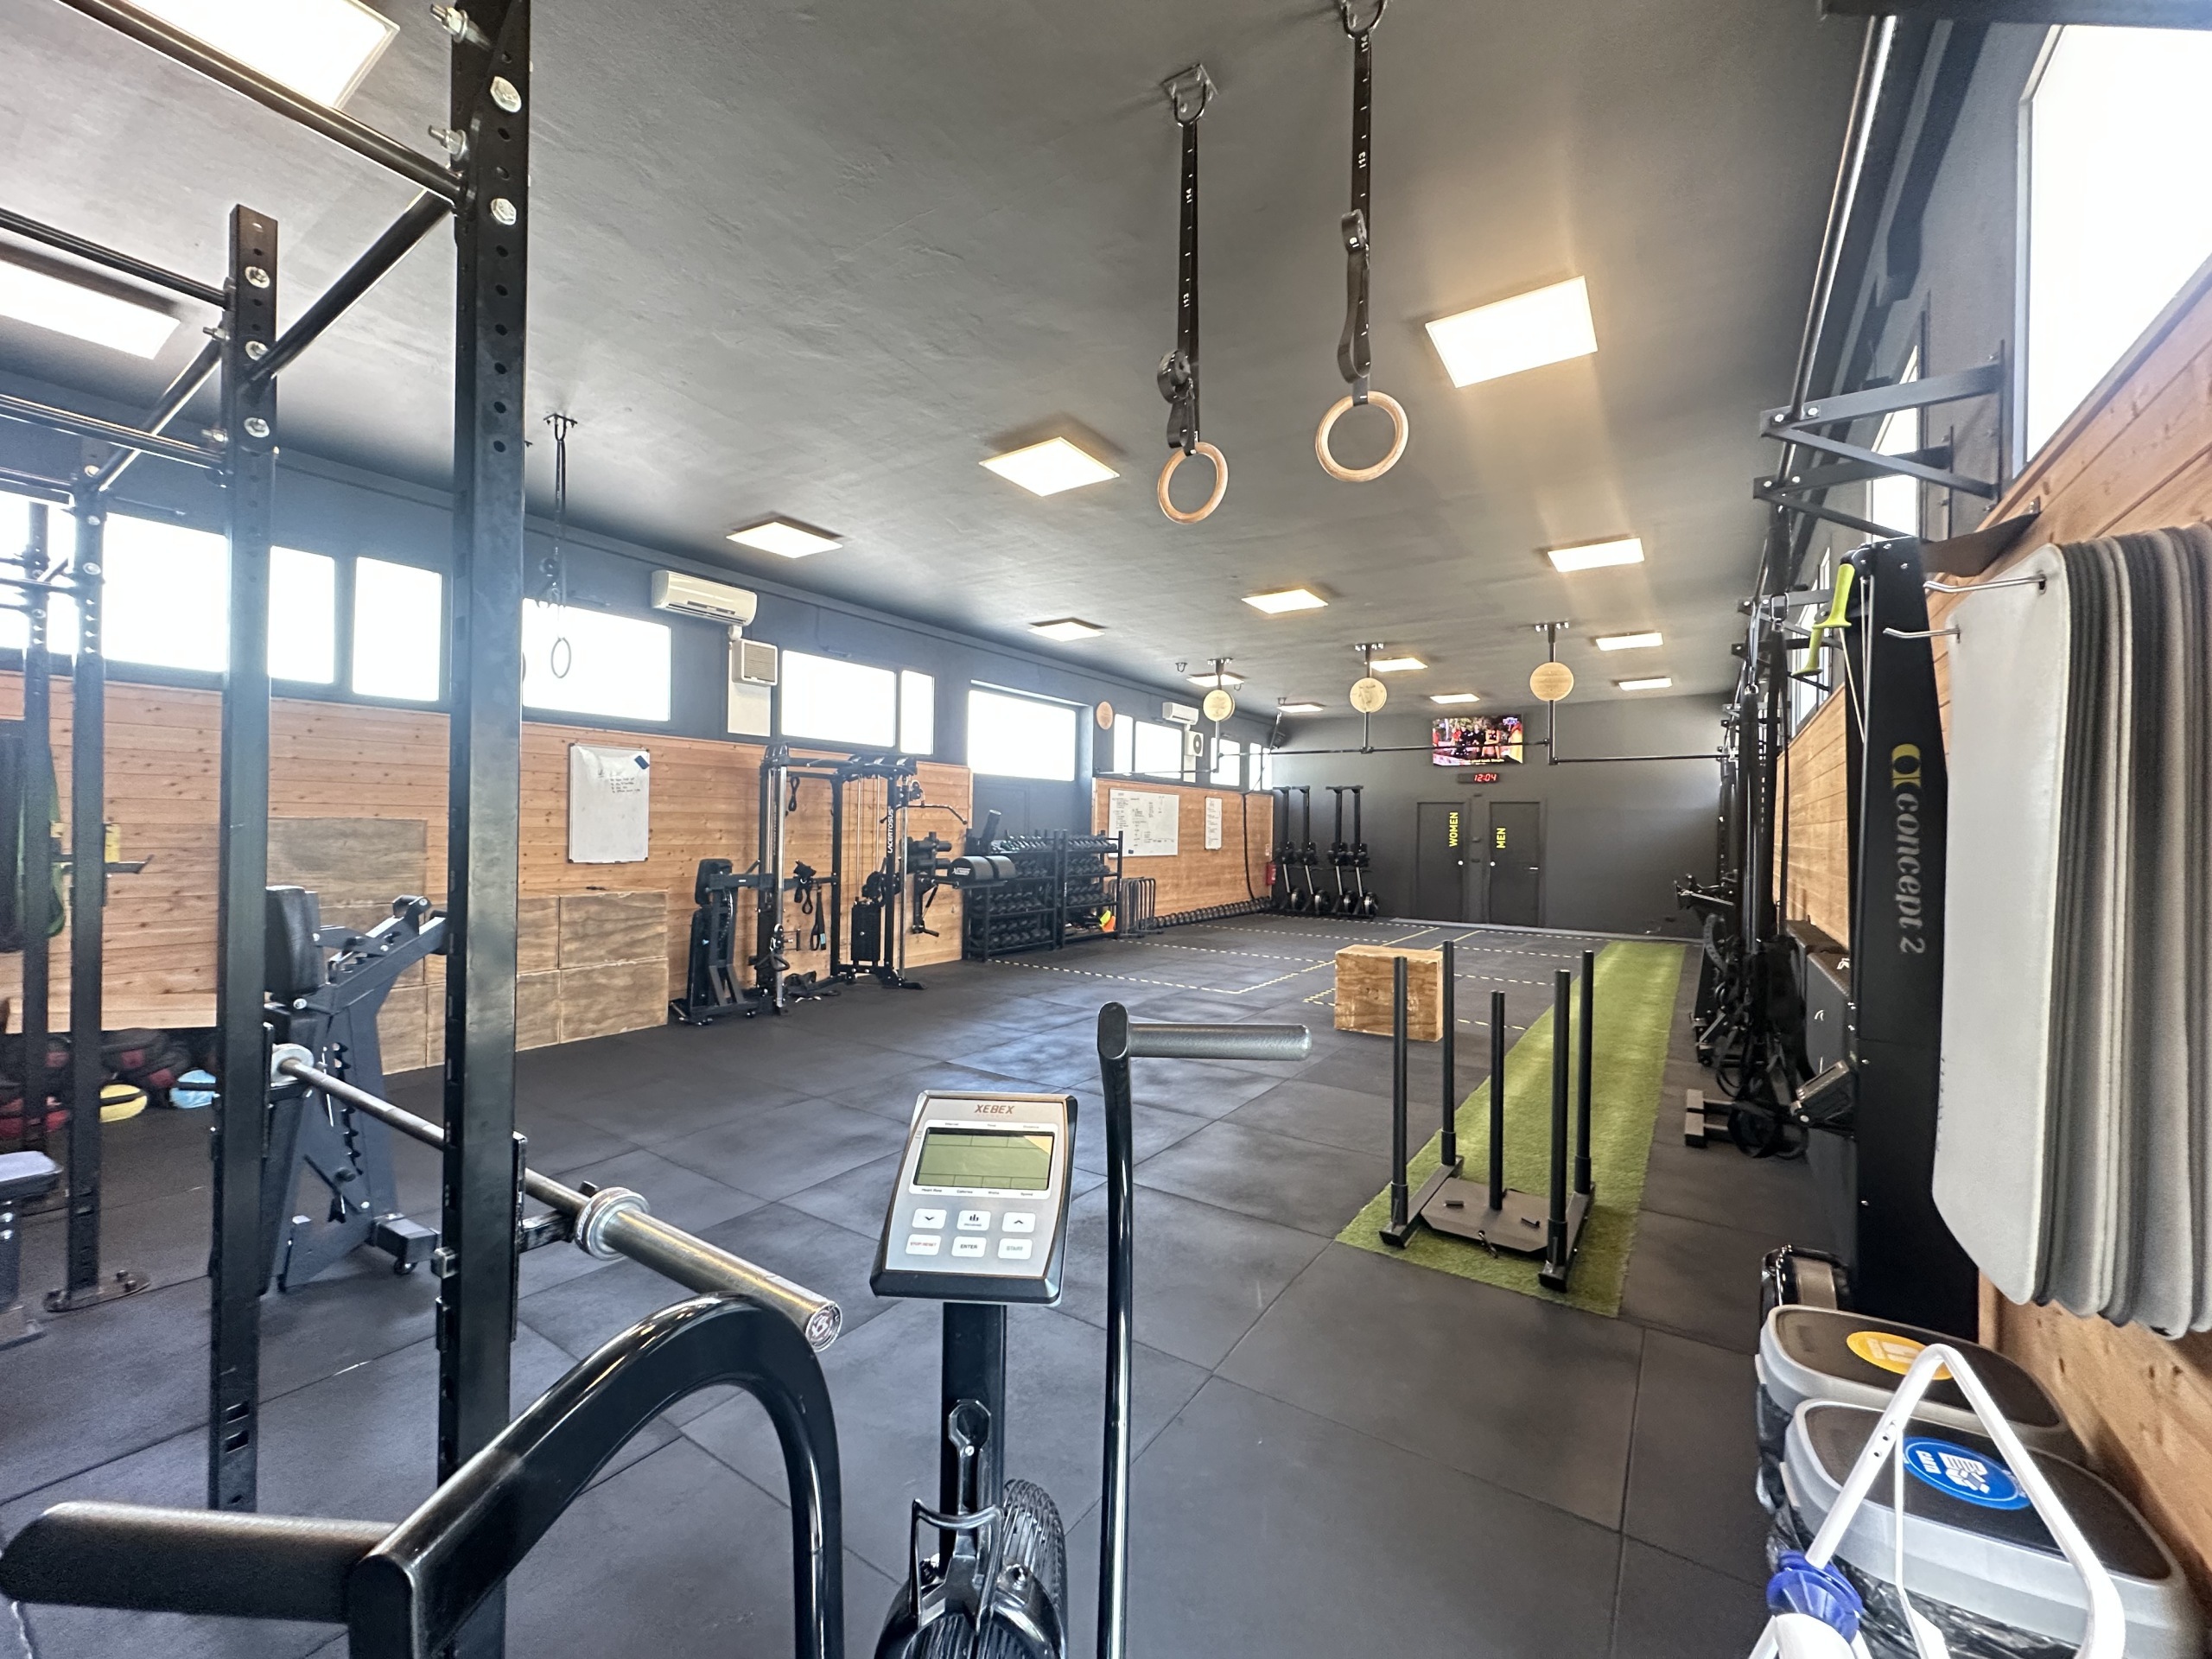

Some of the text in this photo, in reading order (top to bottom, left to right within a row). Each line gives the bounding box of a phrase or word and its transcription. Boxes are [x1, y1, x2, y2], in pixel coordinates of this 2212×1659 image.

[1474, 773, 1497, 782] 12:04
[1449, 811, 1459, 847] WOMEN
[1496, 827, 1506, 849] MEN
[1895, 792, 1923, 929] concept
[974, 1104, 1015, 1115] XEBEX
